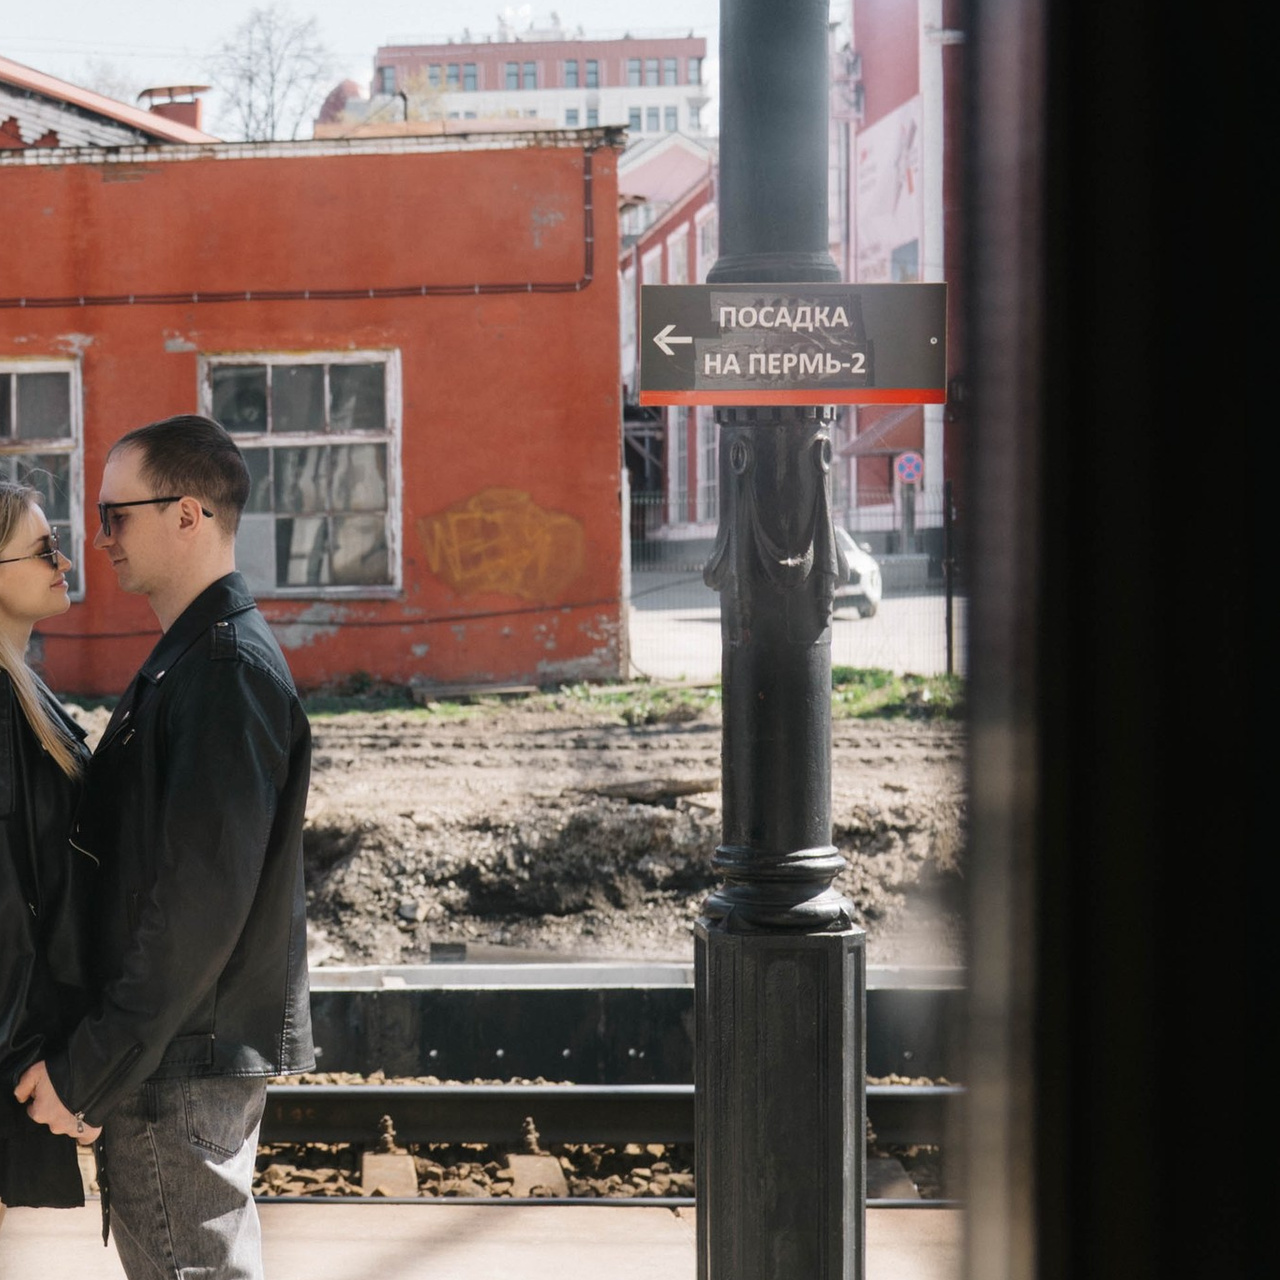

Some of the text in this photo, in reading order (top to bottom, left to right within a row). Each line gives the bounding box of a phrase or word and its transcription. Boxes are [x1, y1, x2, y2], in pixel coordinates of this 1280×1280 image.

[719, 305, 849, 332] ПОСАДКА
[704, 352, 866, 375] НА ПЕРМЬ-2
